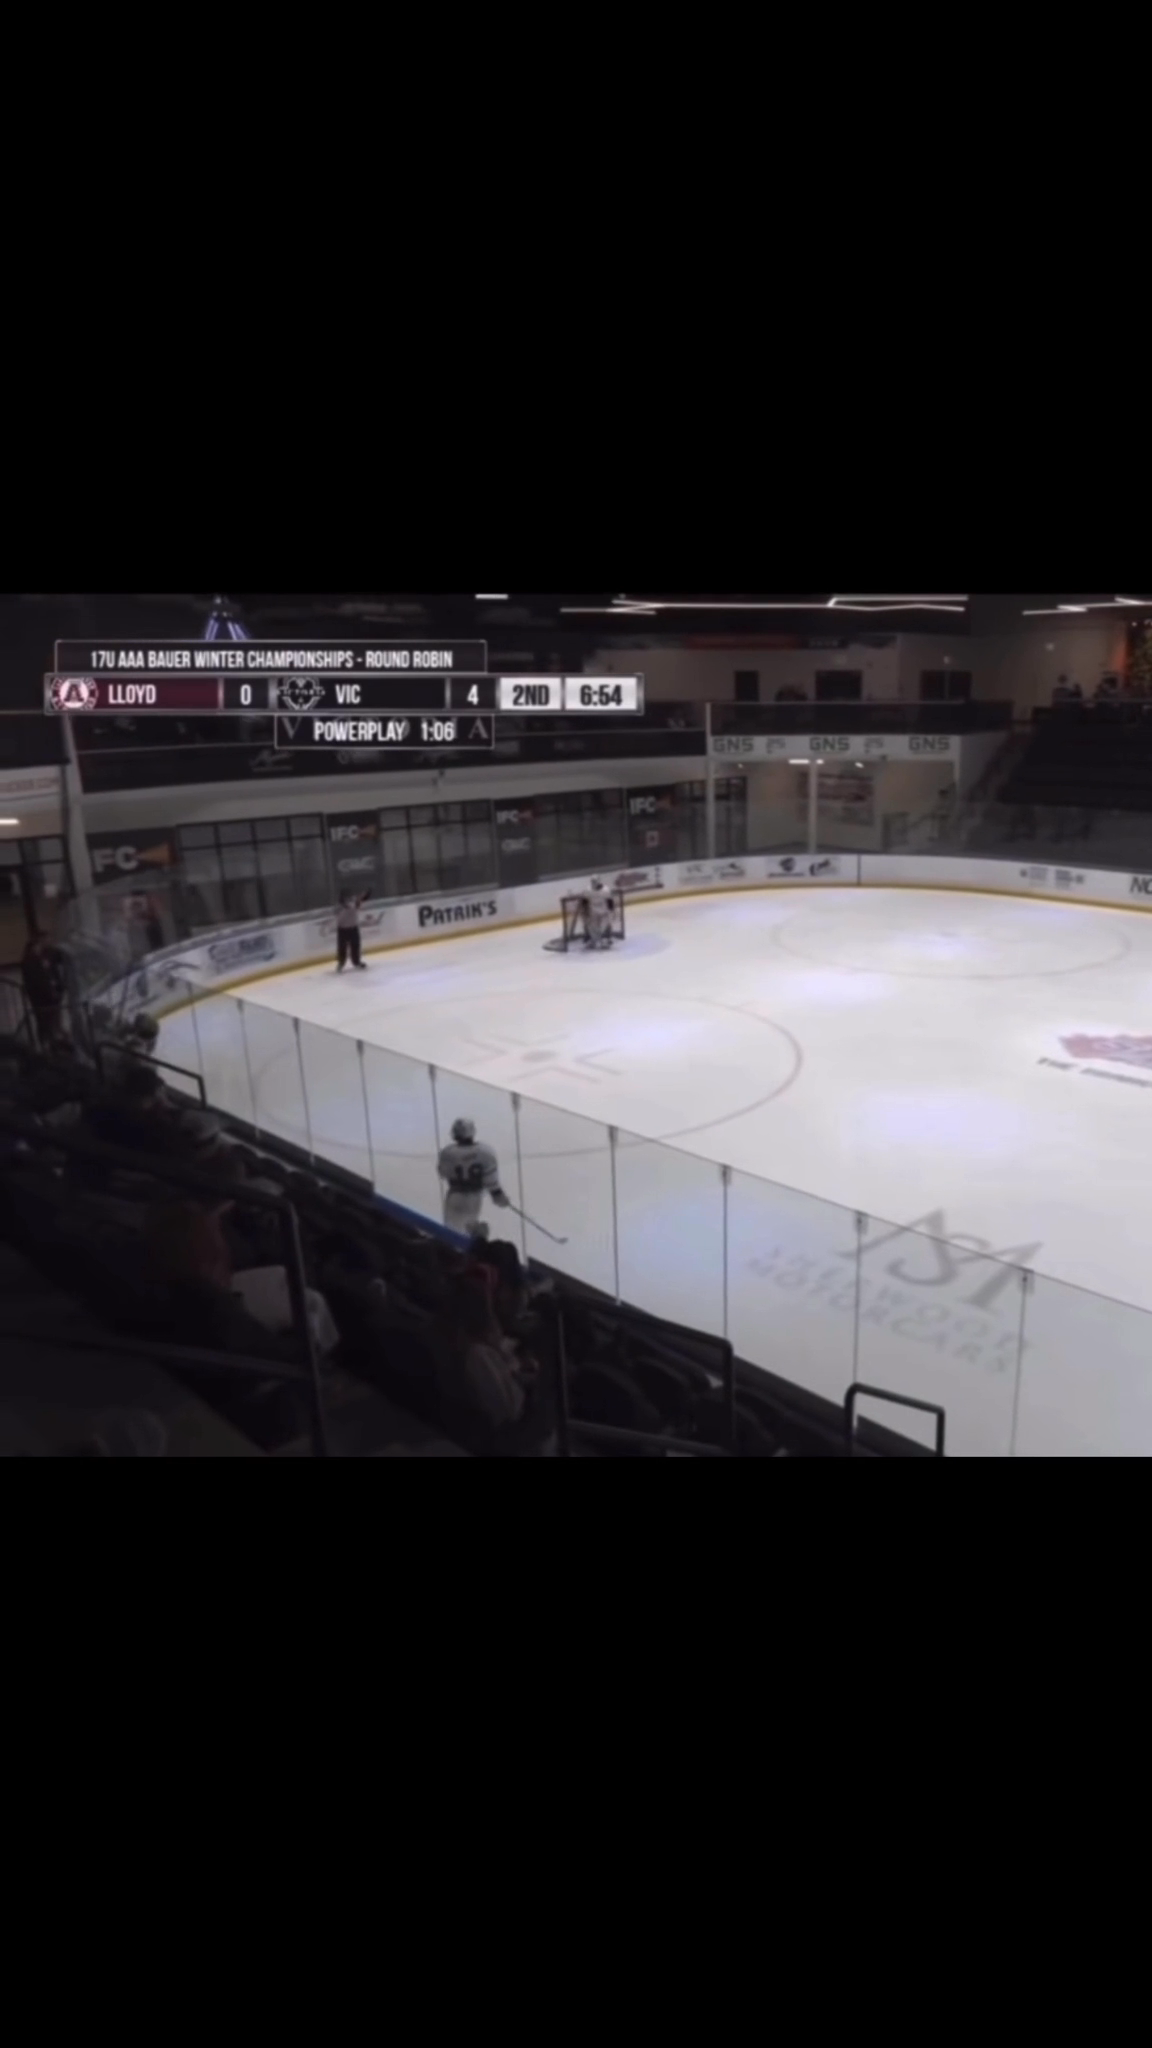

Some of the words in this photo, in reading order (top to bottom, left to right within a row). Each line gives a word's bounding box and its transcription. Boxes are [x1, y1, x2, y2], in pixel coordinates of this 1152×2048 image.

[712, 737, 754, 752] GNS
[809, 737, 849, 751] GNS
[908, 736, 951, 751] GNS
[630, 796, 656, 815] IFC
[330, 825, 359, 842] IFC
